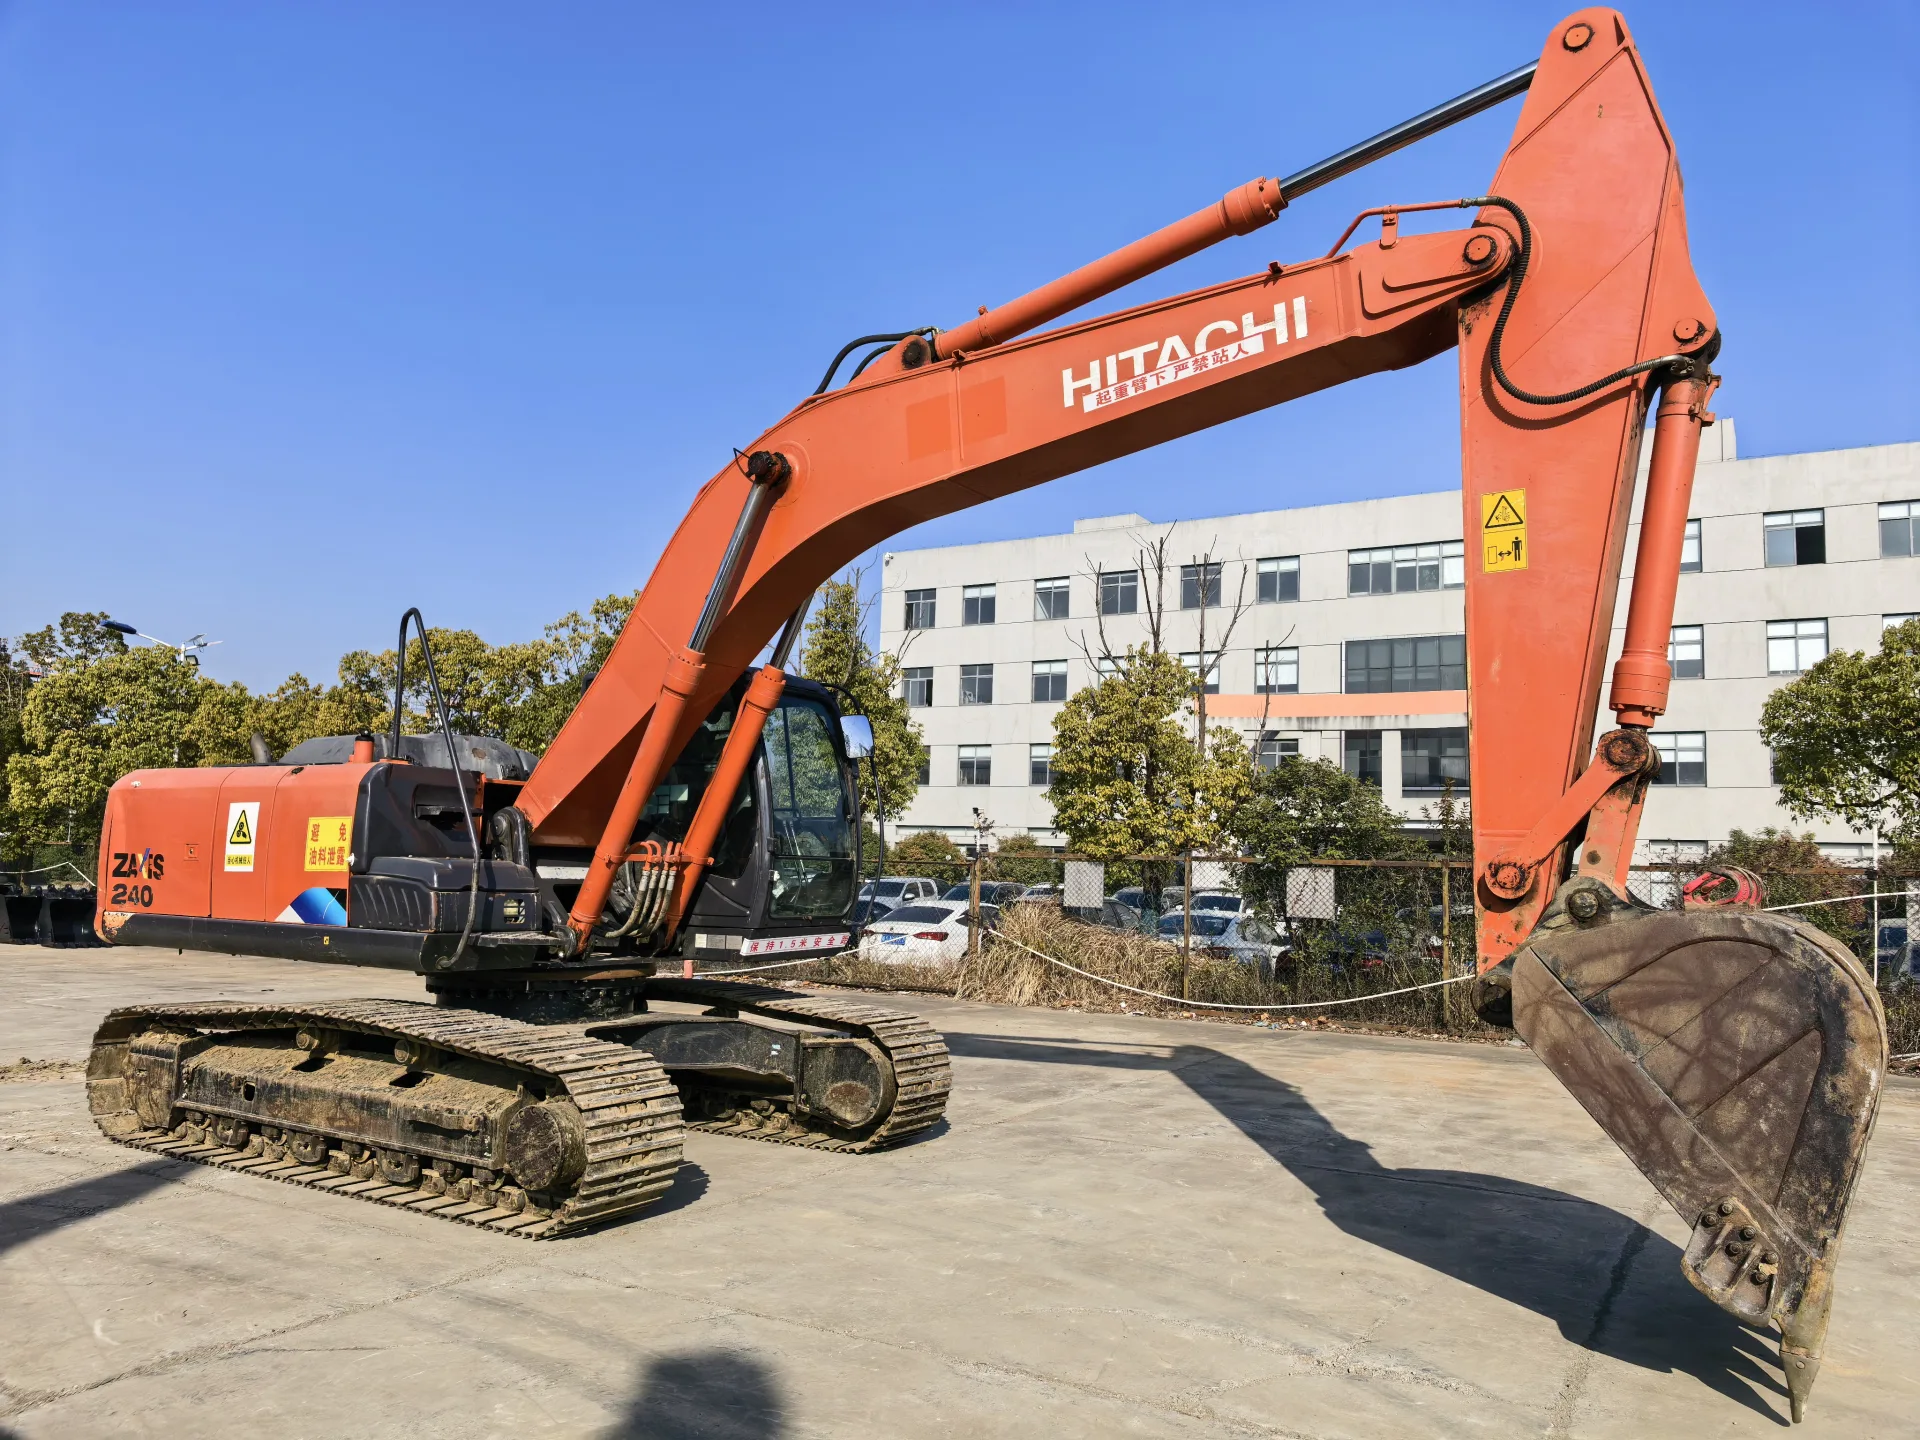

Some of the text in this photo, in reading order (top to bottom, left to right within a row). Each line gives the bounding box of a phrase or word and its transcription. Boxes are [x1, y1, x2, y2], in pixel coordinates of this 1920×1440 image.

[1061, 295, 1309, 408] HITACHI
[1096, 342, 1249, 406] 起重臂下严禁站人
[308, 846, 345, 866] 油料泄露
[111, 883, 154, 908] 240
